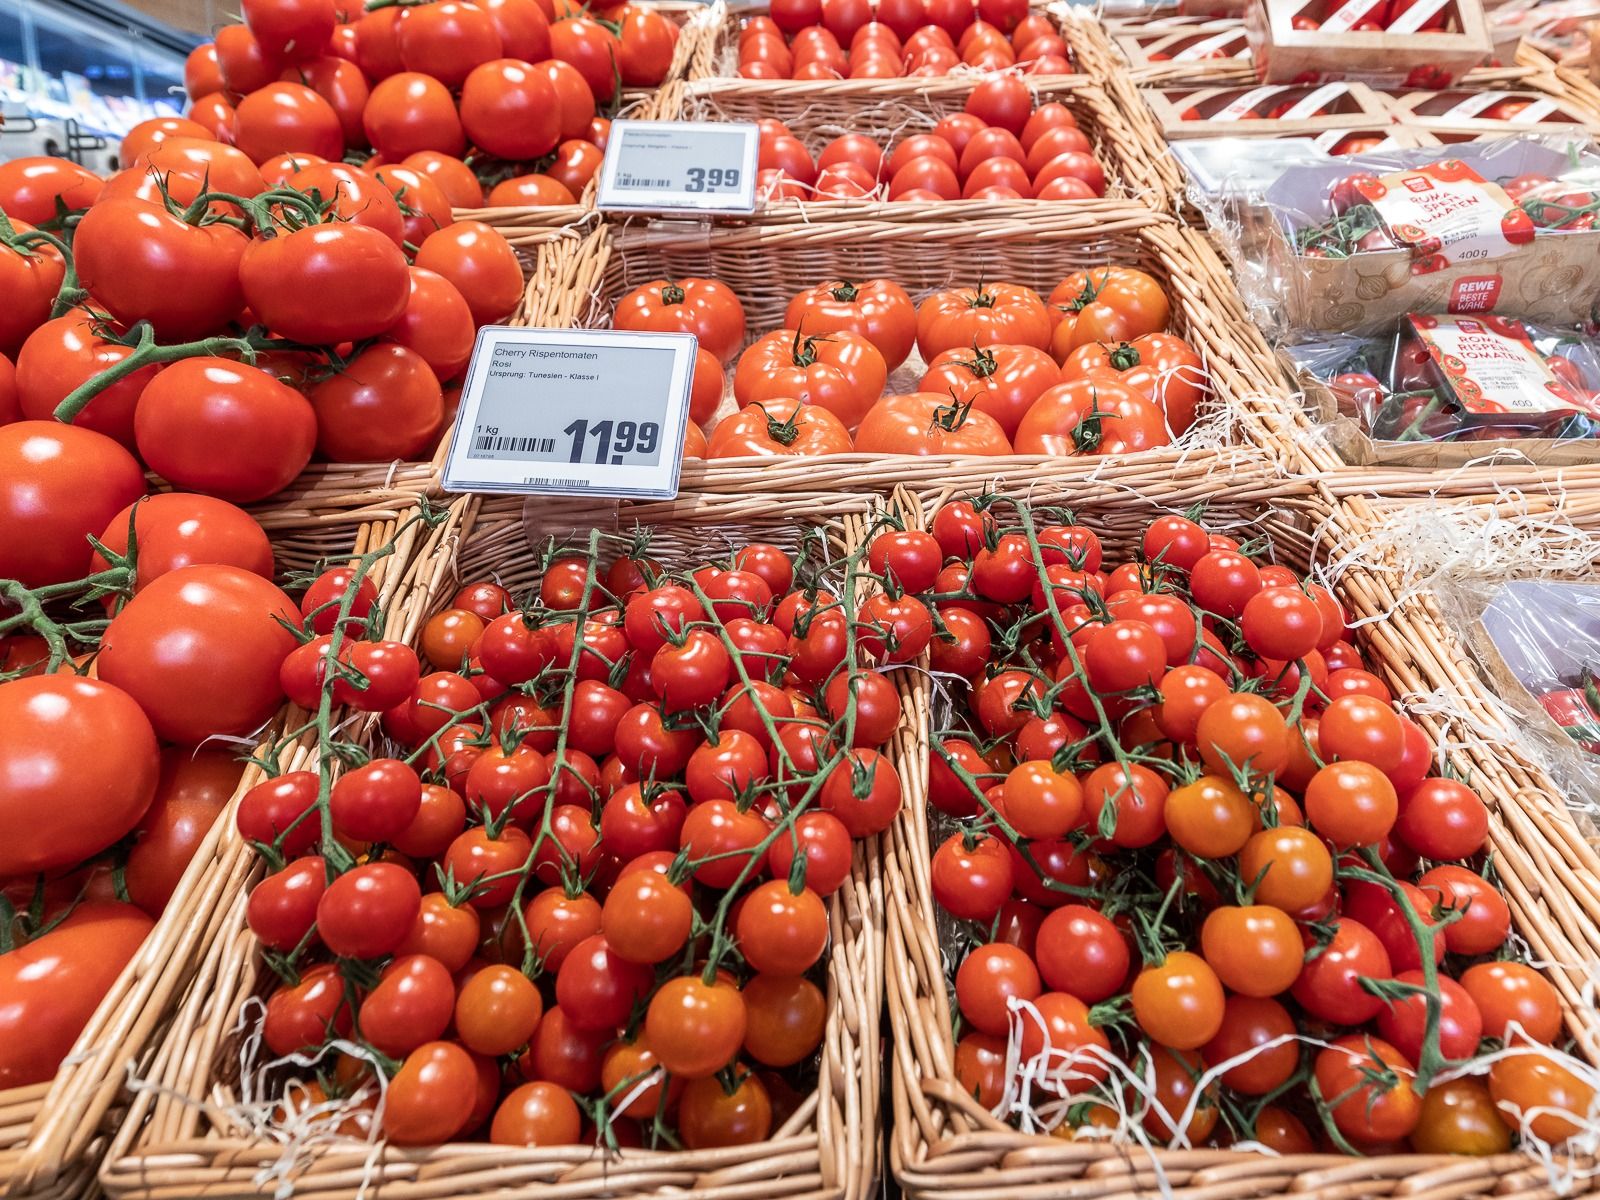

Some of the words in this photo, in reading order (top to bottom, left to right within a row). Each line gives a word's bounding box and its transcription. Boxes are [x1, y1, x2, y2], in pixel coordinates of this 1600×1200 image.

[684, 167, 740, 193] 3.99
[1458, 249, 1480, 259] 400
[1481, 249, 1488, 258] g
[1458, 280, 1496, 293] REWE
[1459, 292, 1489, 302] BESTE
[1457, 301, 1486, 310] WAHL
[495, 348, 525, 358] Cherry
[528, 349, 598, 360] Rispentomaten
[1457, 352, 1527, 363] TOMATEN
[492, 360, 512, 368] Rosi
[489, 370, 525, 379] Ursprung:
[529, 371, 563, 379] Tunesien
[476, 425, 482, 433] 1
[485, 425, 499, 436] kg
[563, 419, 660, 465] 11.99
